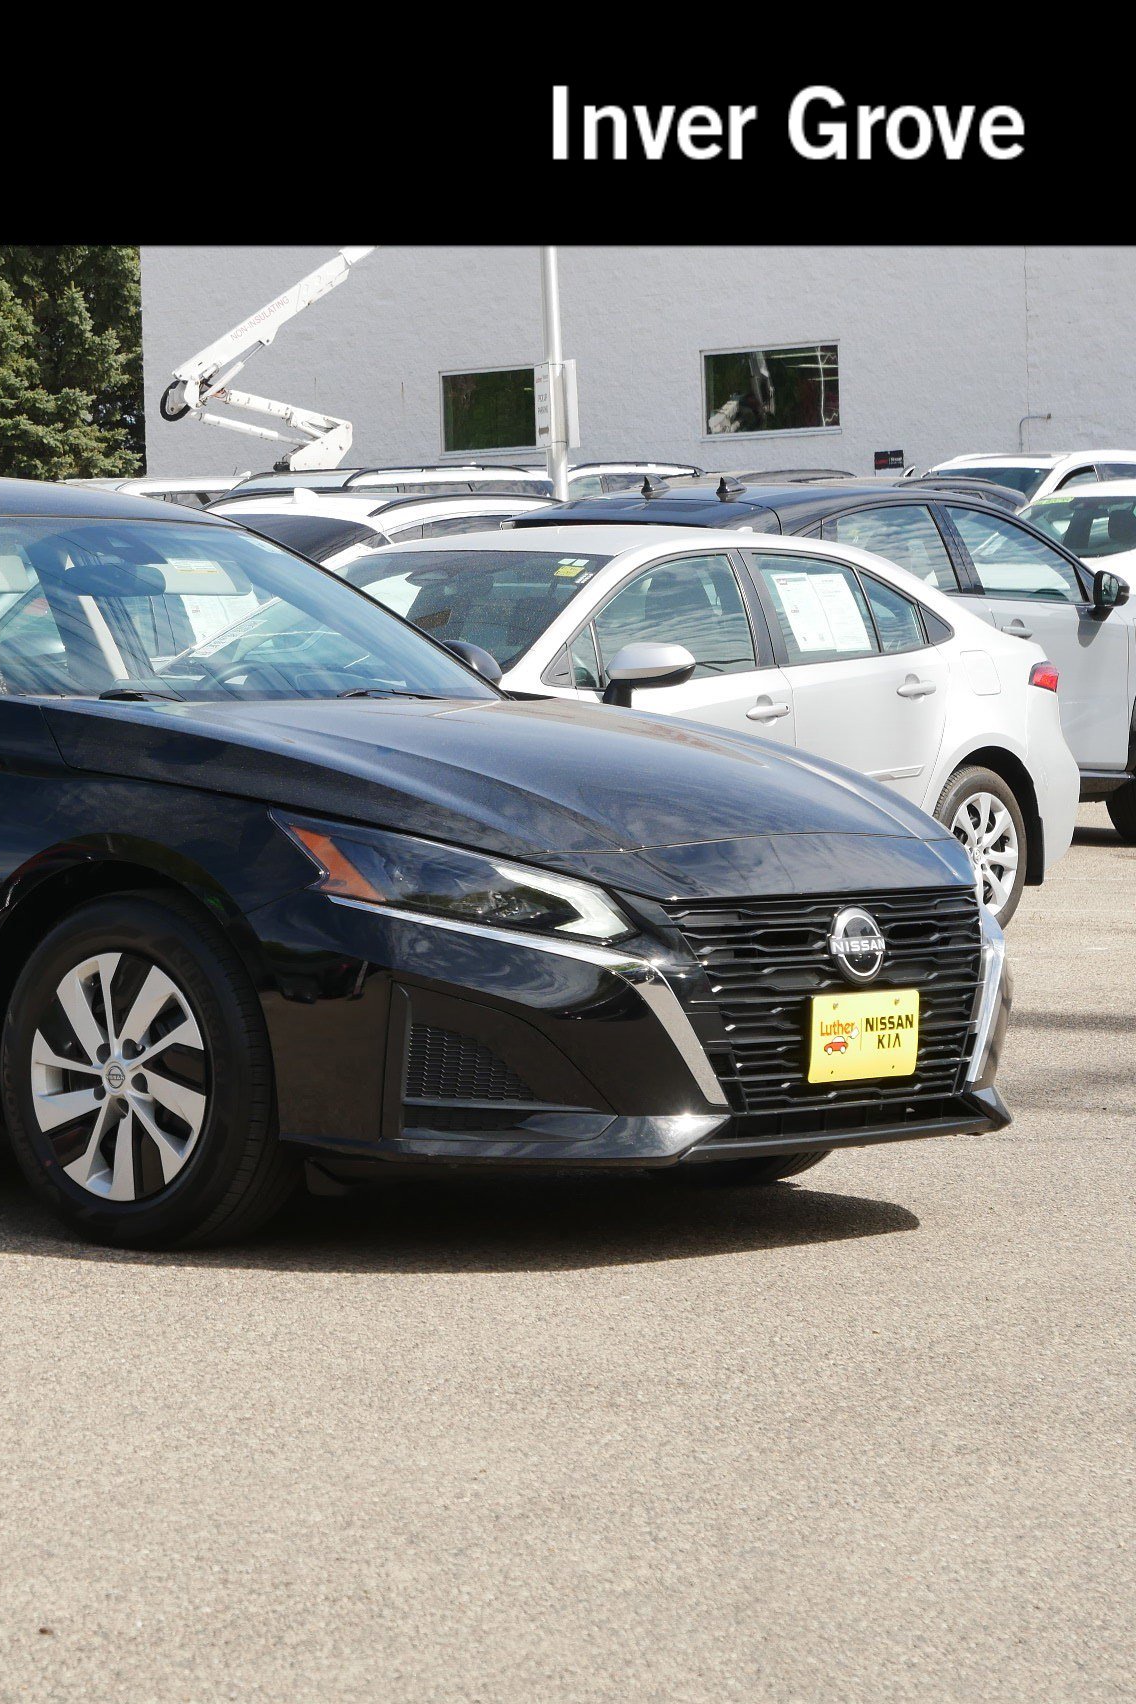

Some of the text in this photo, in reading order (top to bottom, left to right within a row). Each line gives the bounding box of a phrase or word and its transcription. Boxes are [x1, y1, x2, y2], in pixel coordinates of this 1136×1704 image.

[230, 295, 290, 341] NON-INSULATING
[832, 938, 886, 953] NISSAN
[820, 1014, 914, 1037] Luther NISSAN
[877, 1033, 902, 1050] KIA
